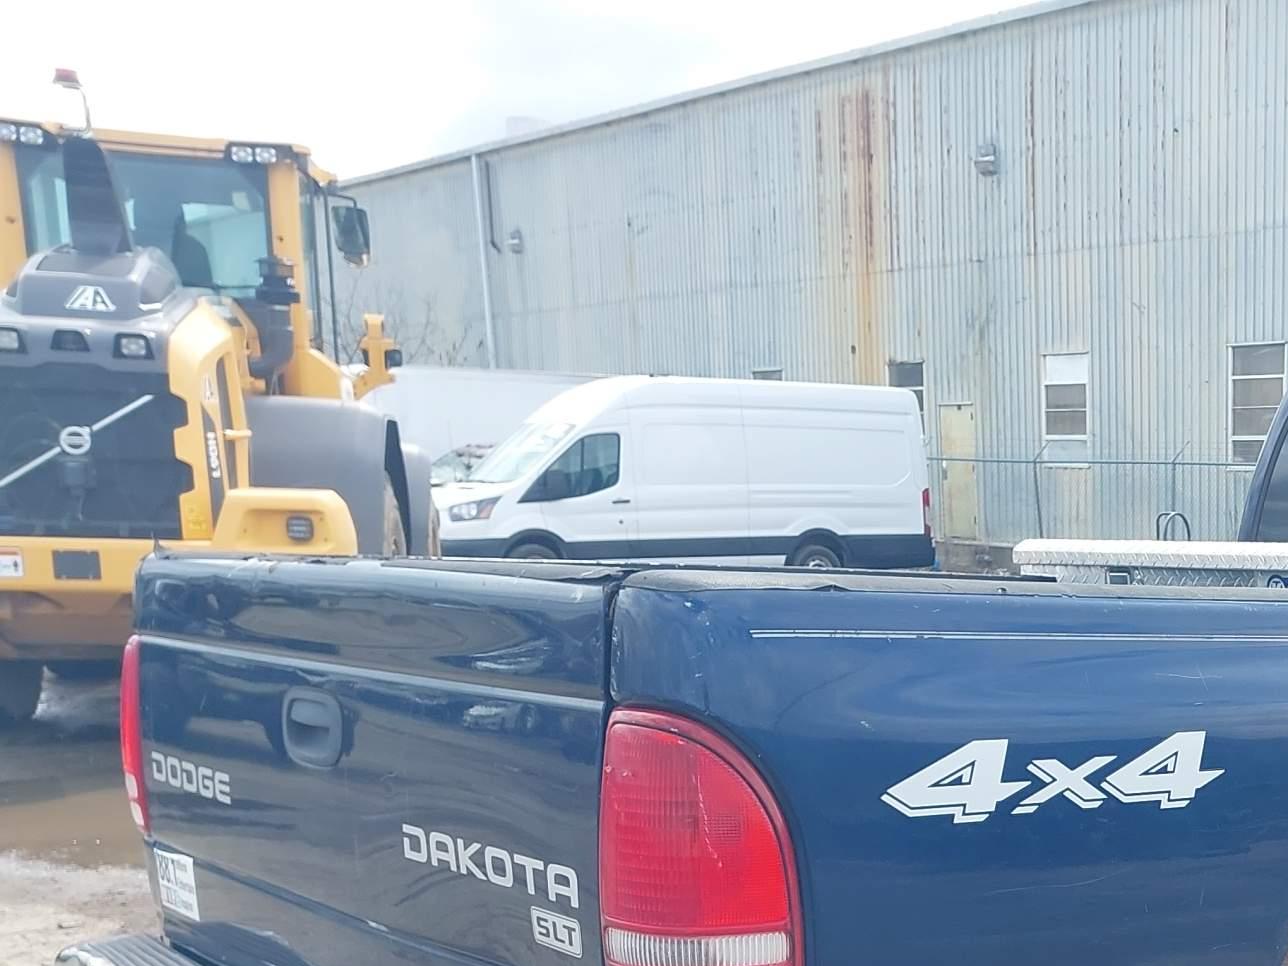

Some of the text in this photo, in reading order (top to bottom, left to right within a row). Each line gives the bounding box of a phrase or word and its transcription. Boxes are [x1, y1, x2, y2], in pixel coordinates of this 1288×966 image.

[151, 750, 231, 805] DODGE
[402, 823, 579, 909] DAKOTA
[536, 916, 576, 947] SLT
